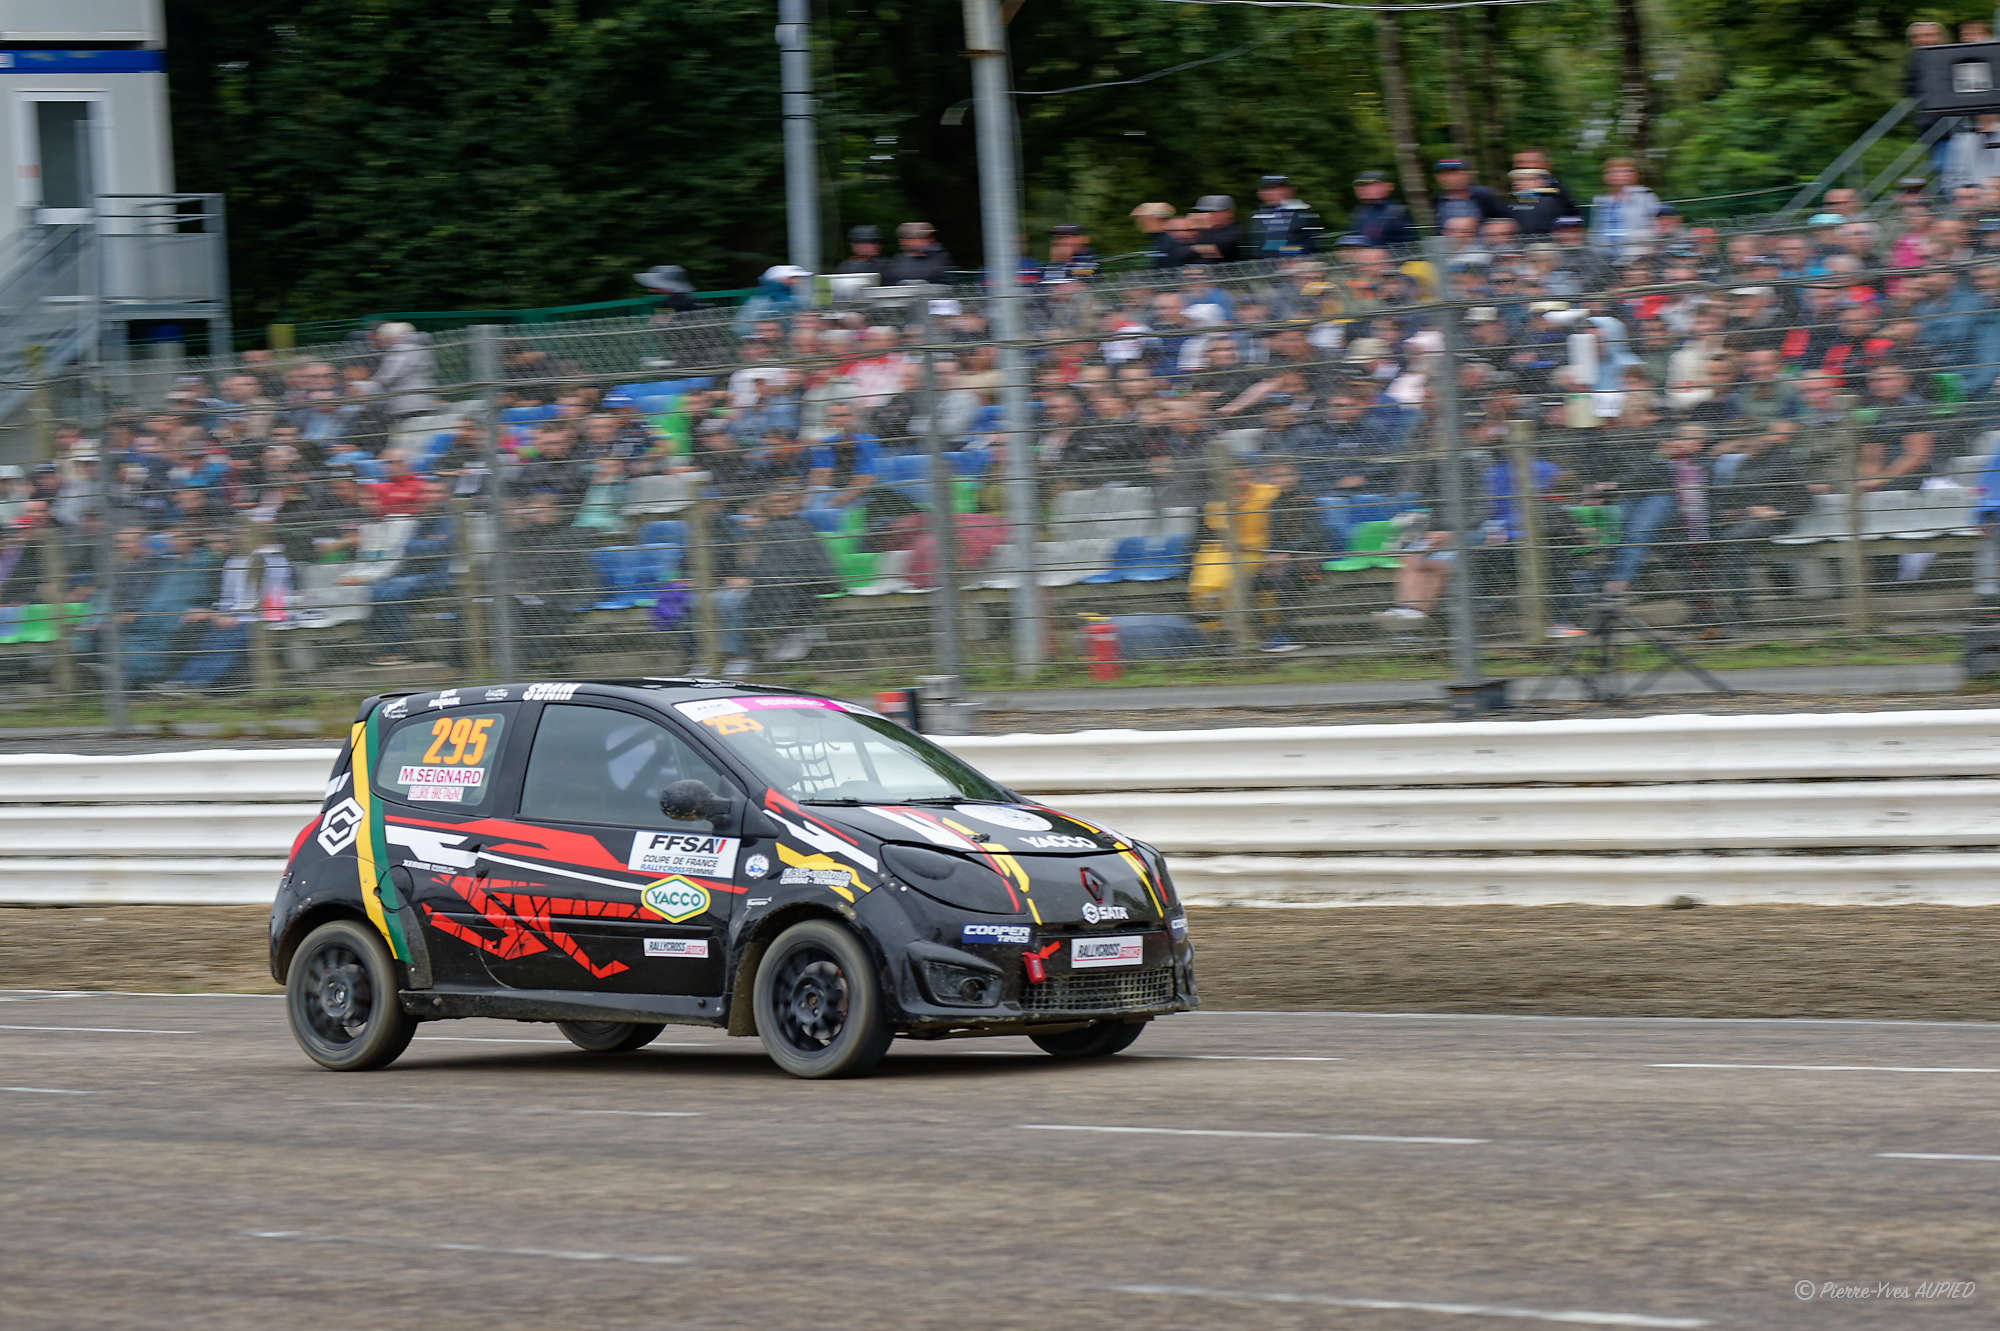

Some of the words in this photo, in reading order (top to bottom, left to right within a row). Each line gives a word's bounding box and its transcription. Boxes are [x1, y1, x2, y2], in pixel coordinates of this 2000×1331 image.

[422, 717, 494, 766] 295
[401, 767, 481, 784] M.SEIGNARD
[649, 834, 715, 854] FFSA
[1018, 835, 1098, 849] YACCO
[643, 854, 671, 863] COUPE
[672, 856, 685, 865] DE
[685, 857, 718, 868] FRANCE
[652, 891, 701, 906] YACCO
[1100, 905, 1129, 920] SATA
[963, 924, 1031, 937] COOPER
[649, 941, 686, 953] RALLYCROSS
[997, 935, 1029, 944] TIRES
[1077, 943, 1121, 958] RALLYCROSS
